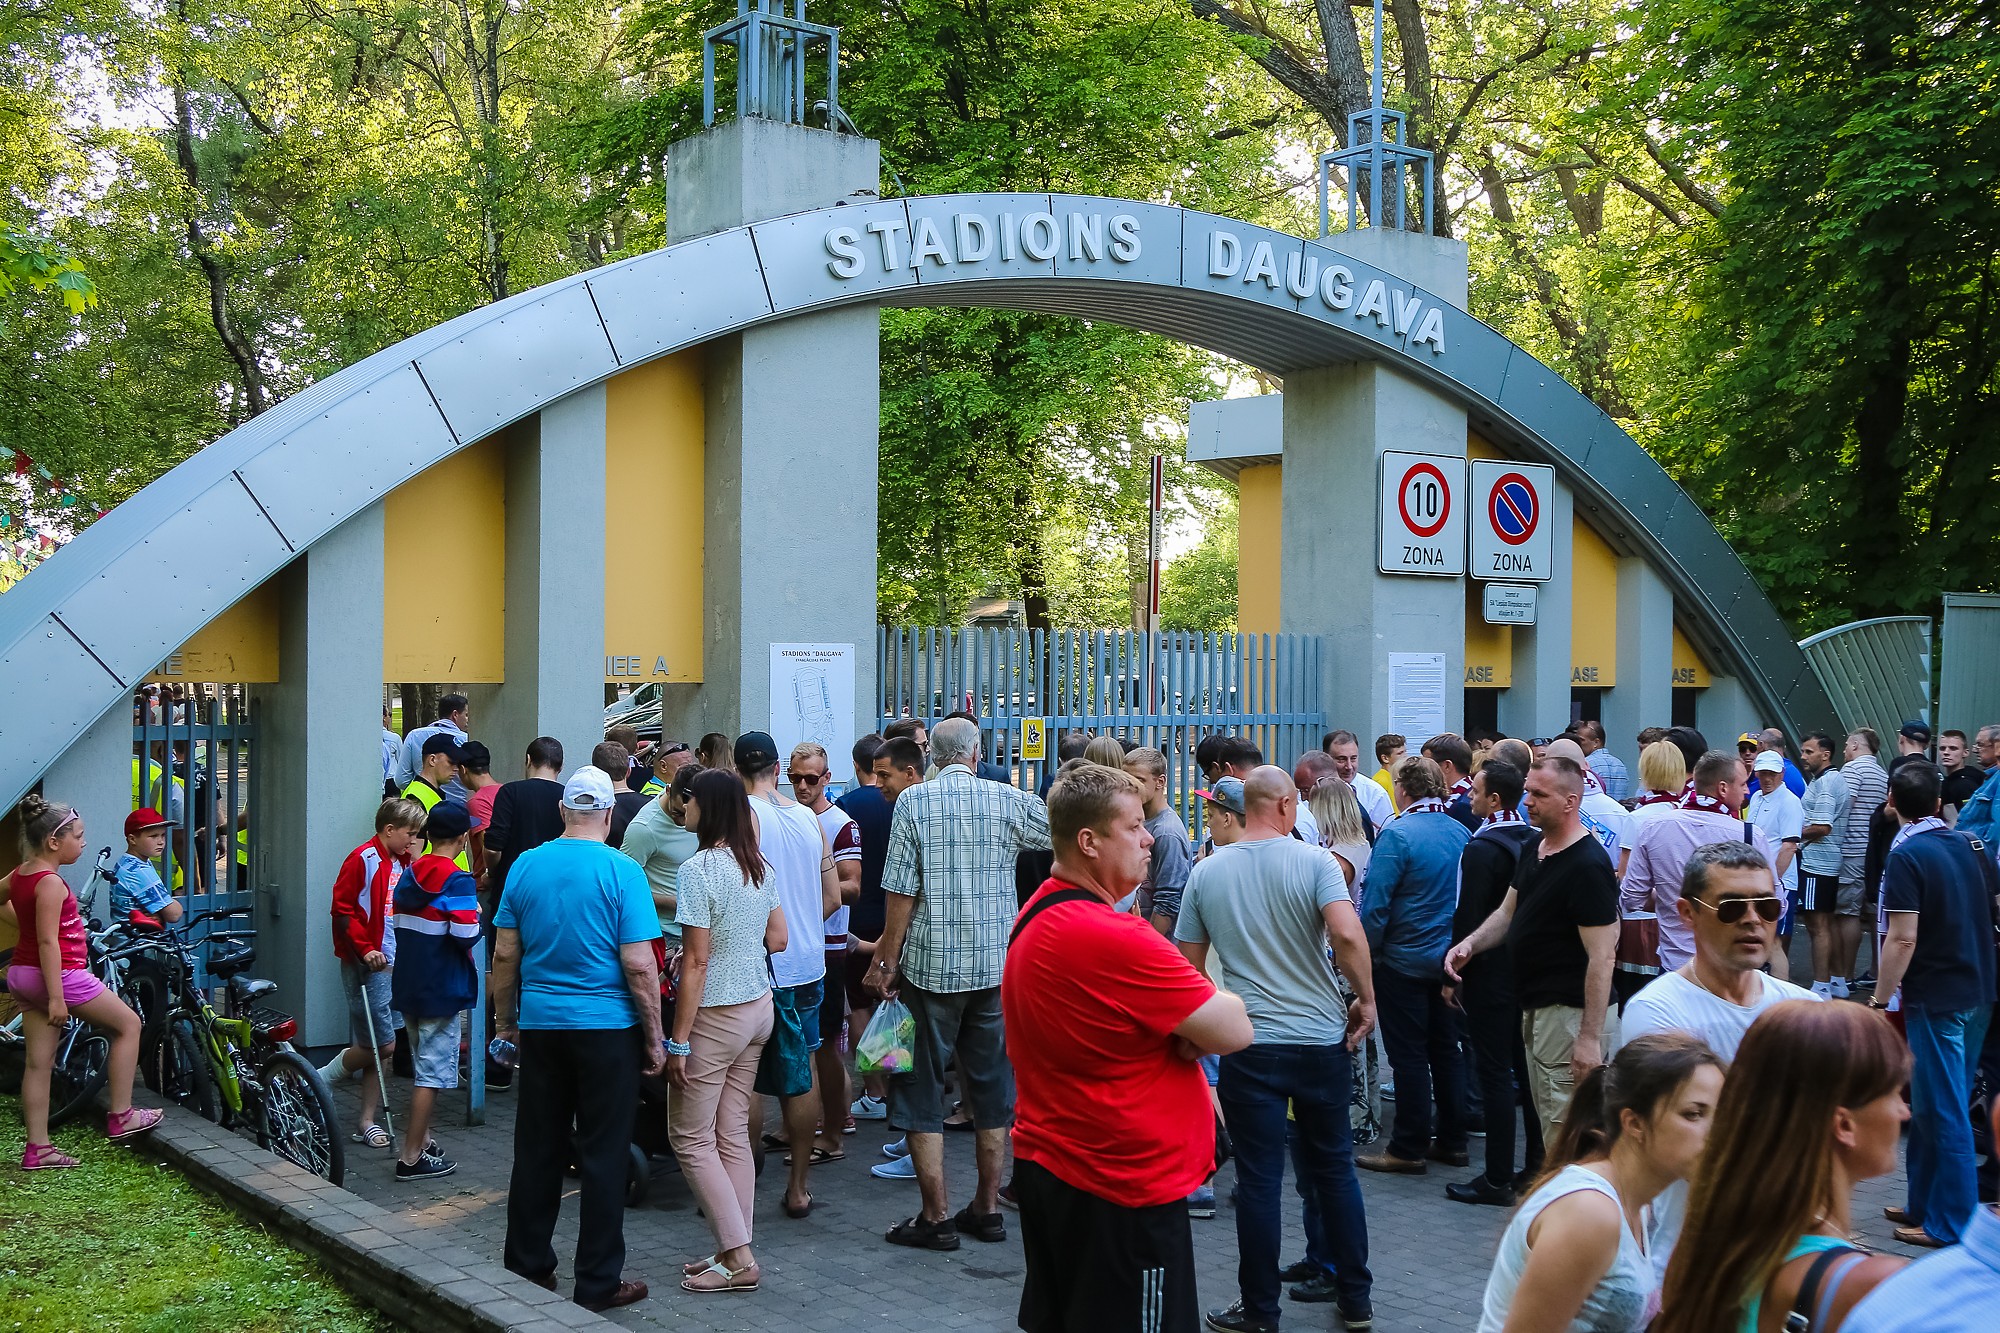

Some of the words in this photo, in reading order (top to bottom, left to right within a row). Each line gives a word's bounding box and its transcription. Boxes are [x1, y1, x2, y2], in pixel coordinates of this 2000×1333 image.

[825, 211, 1142, 279] STADIONS
[1208, 230, 1446, 354] DAUGAVA
[1413, 481, 1437, 517] 10
[1403, 546, 1444, 566] ZONA
[1493, 553, 1533, 572] ZONA
[652, 656, 670, 676] A
[1464, 666, 1494, 683] ASE
[1570, 666, 1599, 682] ASE
